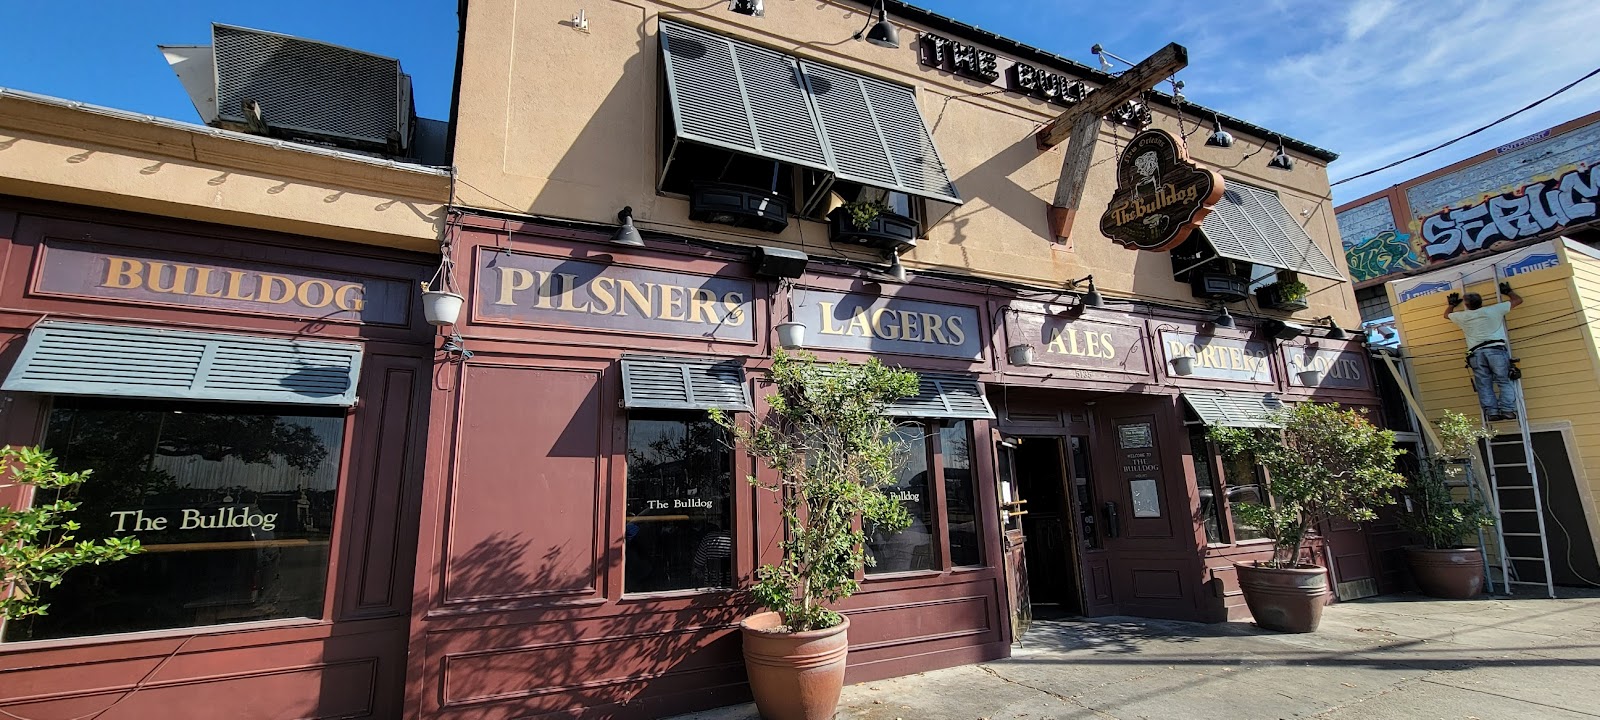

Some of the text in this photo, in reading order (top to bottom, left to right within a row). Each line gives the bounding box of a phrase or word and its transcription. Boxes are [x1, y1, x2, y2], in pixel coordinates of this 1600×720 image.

[920, 32, 999, 79] THE
[1500, 132, 1546, 152] OUTFRONT
[1111, 182, 1199, 226] The Bulldog
[101, 257, 366, 311] BULLDOG
[494, 266, 746, 327] PILSNERS
[819, 301, 965, 345] LAGERS
[1046, 327, 1115, 360] ALES
[1294, 354, 1361, 380] SOUTS
[1123, 464, 1159, 472] BULLDOG
[646, 498, 713, 509] The Bulldog
[889, 491, 920, 503] Bulldog
[110, 506, 278, 532] The Bulldog
